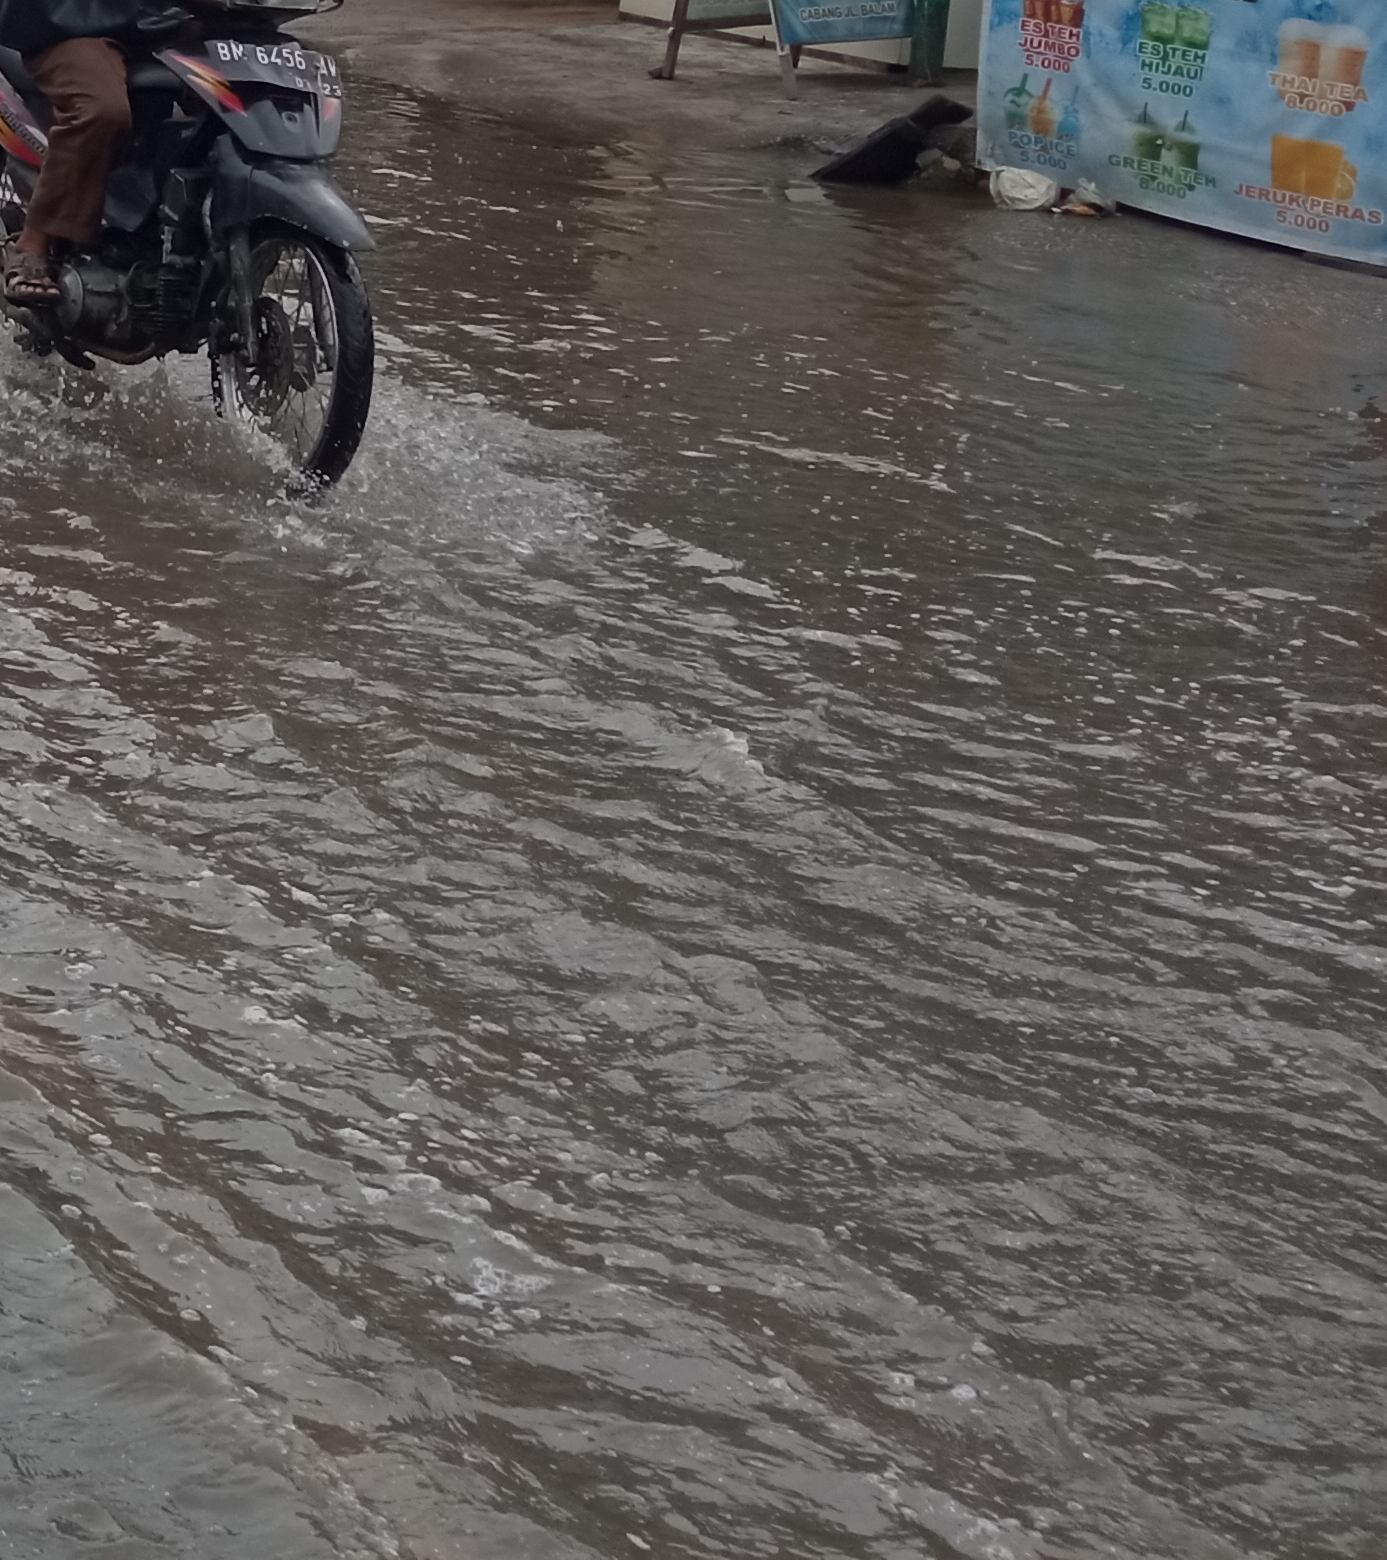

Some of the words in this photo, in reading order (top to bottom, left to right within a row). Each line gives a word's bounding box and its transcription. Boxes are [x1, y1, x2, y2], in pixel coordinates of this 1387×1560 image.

[800, 7, 843, 21] CABANG
[860, 1, 896, 16] BALAM
[1020, 19, 1044, 35] ES
[1047, 24, 1081, 42] TEH
[256, 47, 306, 70] 6456
[1018, 37, 1080, 58] JUMBO
[1137, 40, 1163, 57] ES
[1167, 45, 1207, 64] TEH
[1025, 53, 1070, 73] 5.000
[1141, 77, 1195, 98] 5.000
[1268, 71, 1317, 93] THAI
[1325, 82, 1369, 103] TEA
[1008, 130, 1045, 149] POP
[1048, 140, 1076, 157] ICE
[1020, 150, 1067, 170] 5.000
[1108, 154, 1174, 178] GREEN
[1233, 183, 1308, 209] JERUK
[1309, 196, 1384, 225] PERAS
[1277, 210, 1330, 233] 5.000
